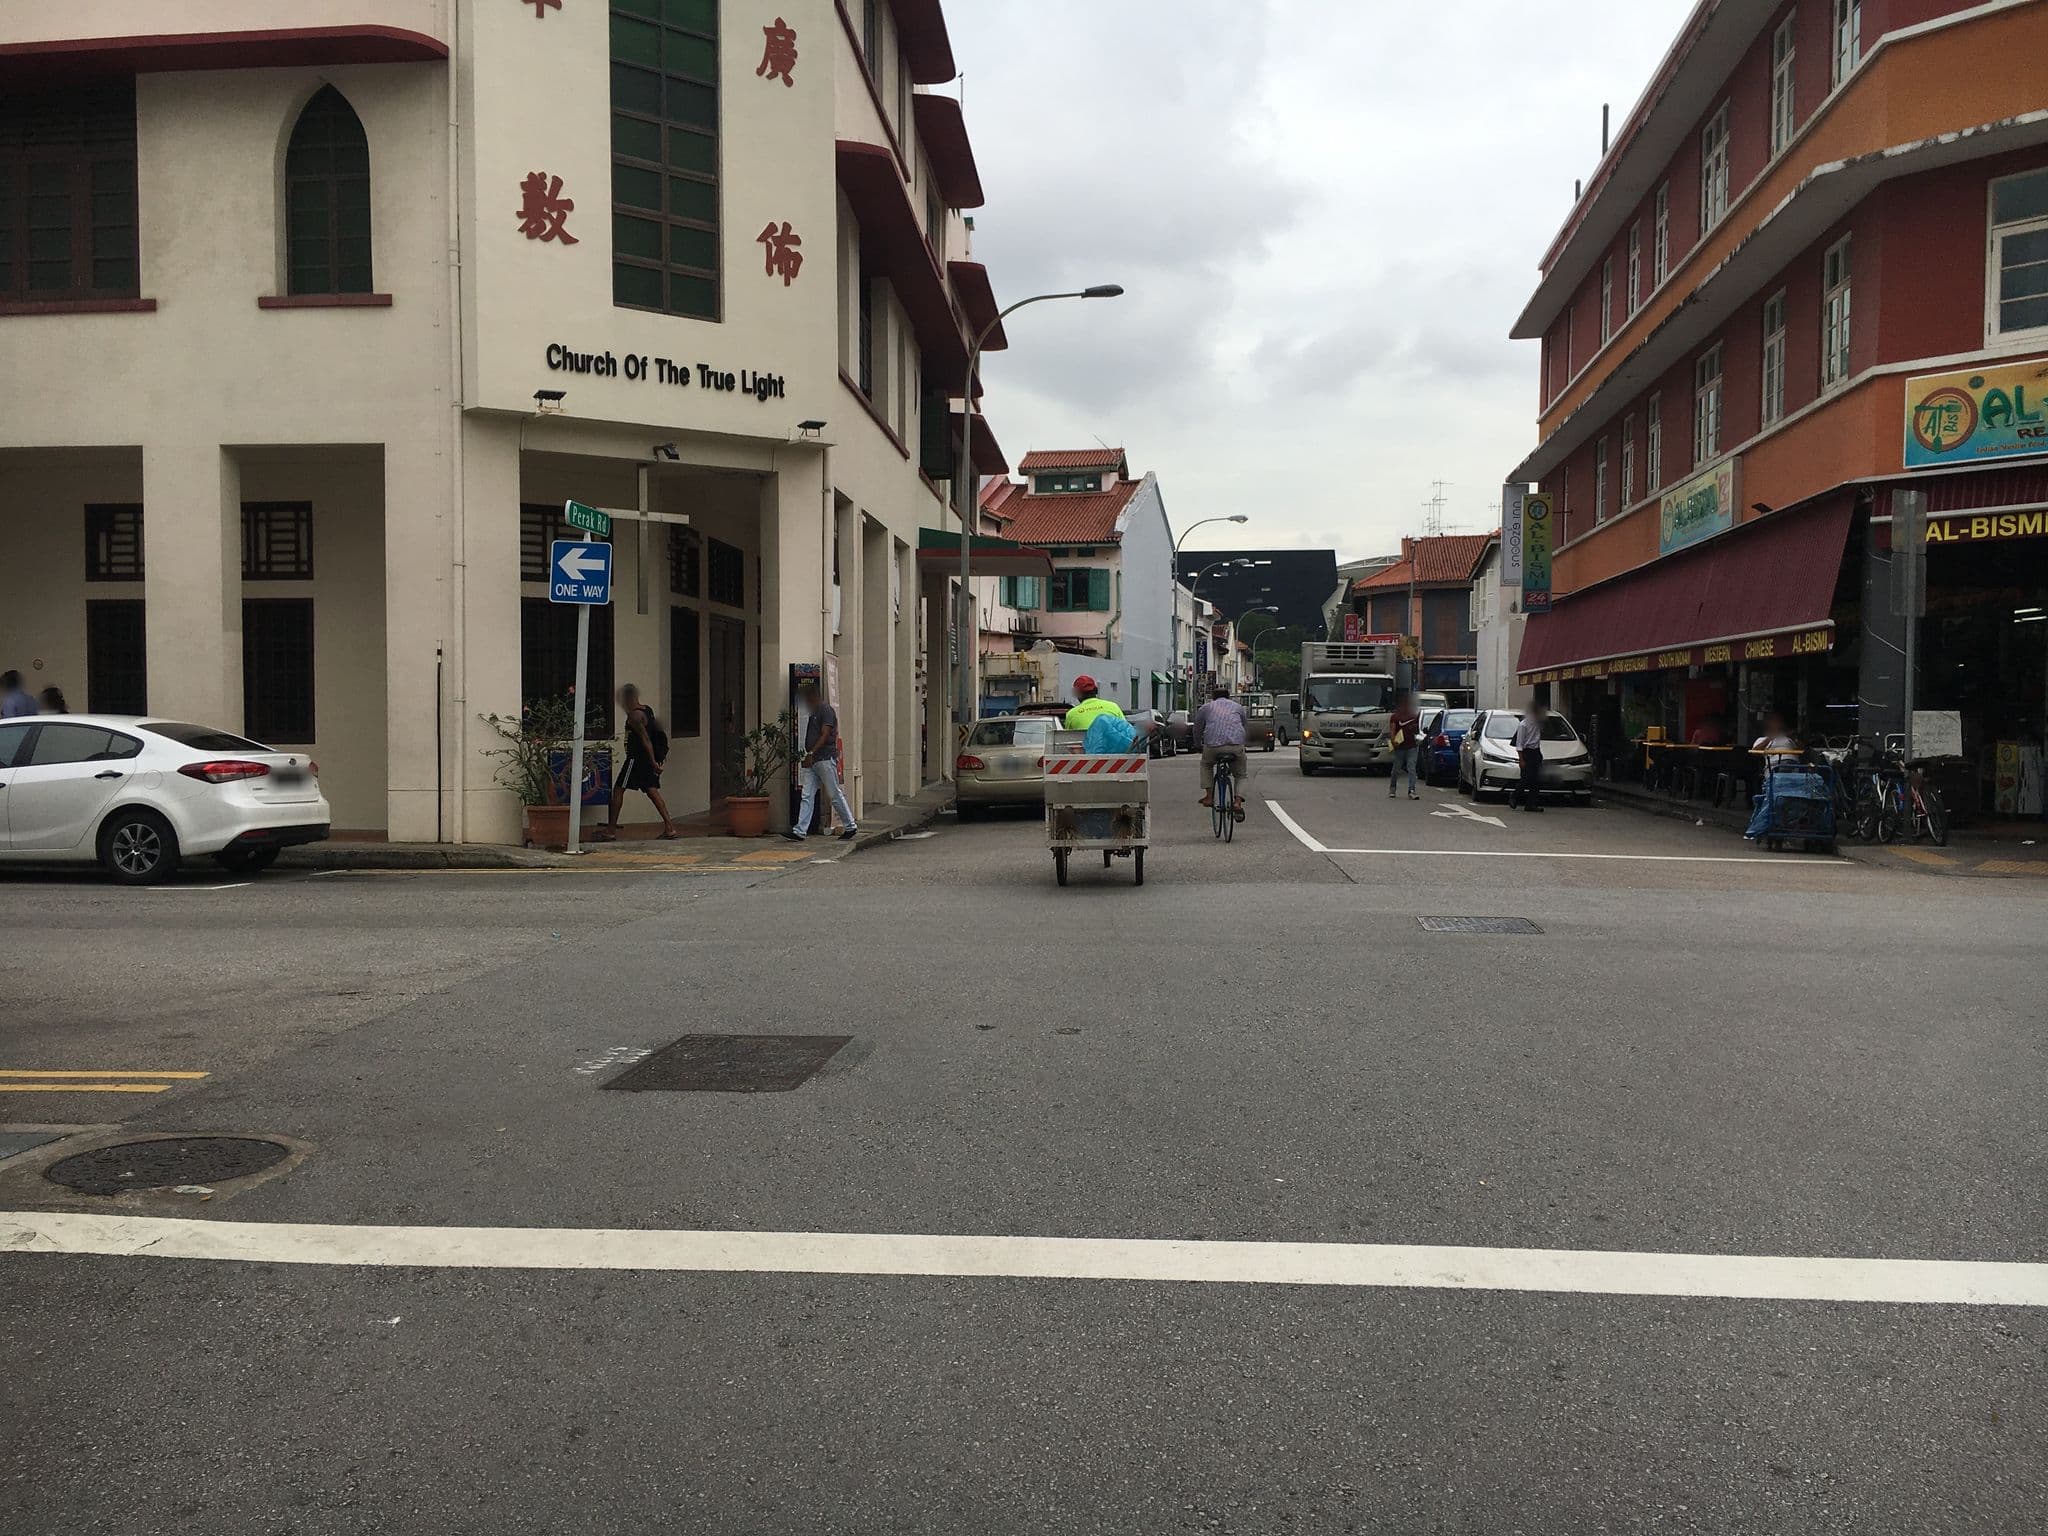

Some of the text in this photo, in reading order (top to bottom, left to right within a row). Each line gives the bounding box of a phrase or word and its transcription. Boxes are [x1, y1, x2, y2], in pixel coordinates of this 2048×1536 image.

[546, 343, 785, 402] Church Of The True Light
[572, 505, 607, 533] Perak Rd
[555, 583, 604, 598] ONE WAY
[1744, 638, 1774, 659] CHINESE
[1792, 631, 1828, 653] AL-BISMI
[1703, 644, 1731, 663] WESTERN
